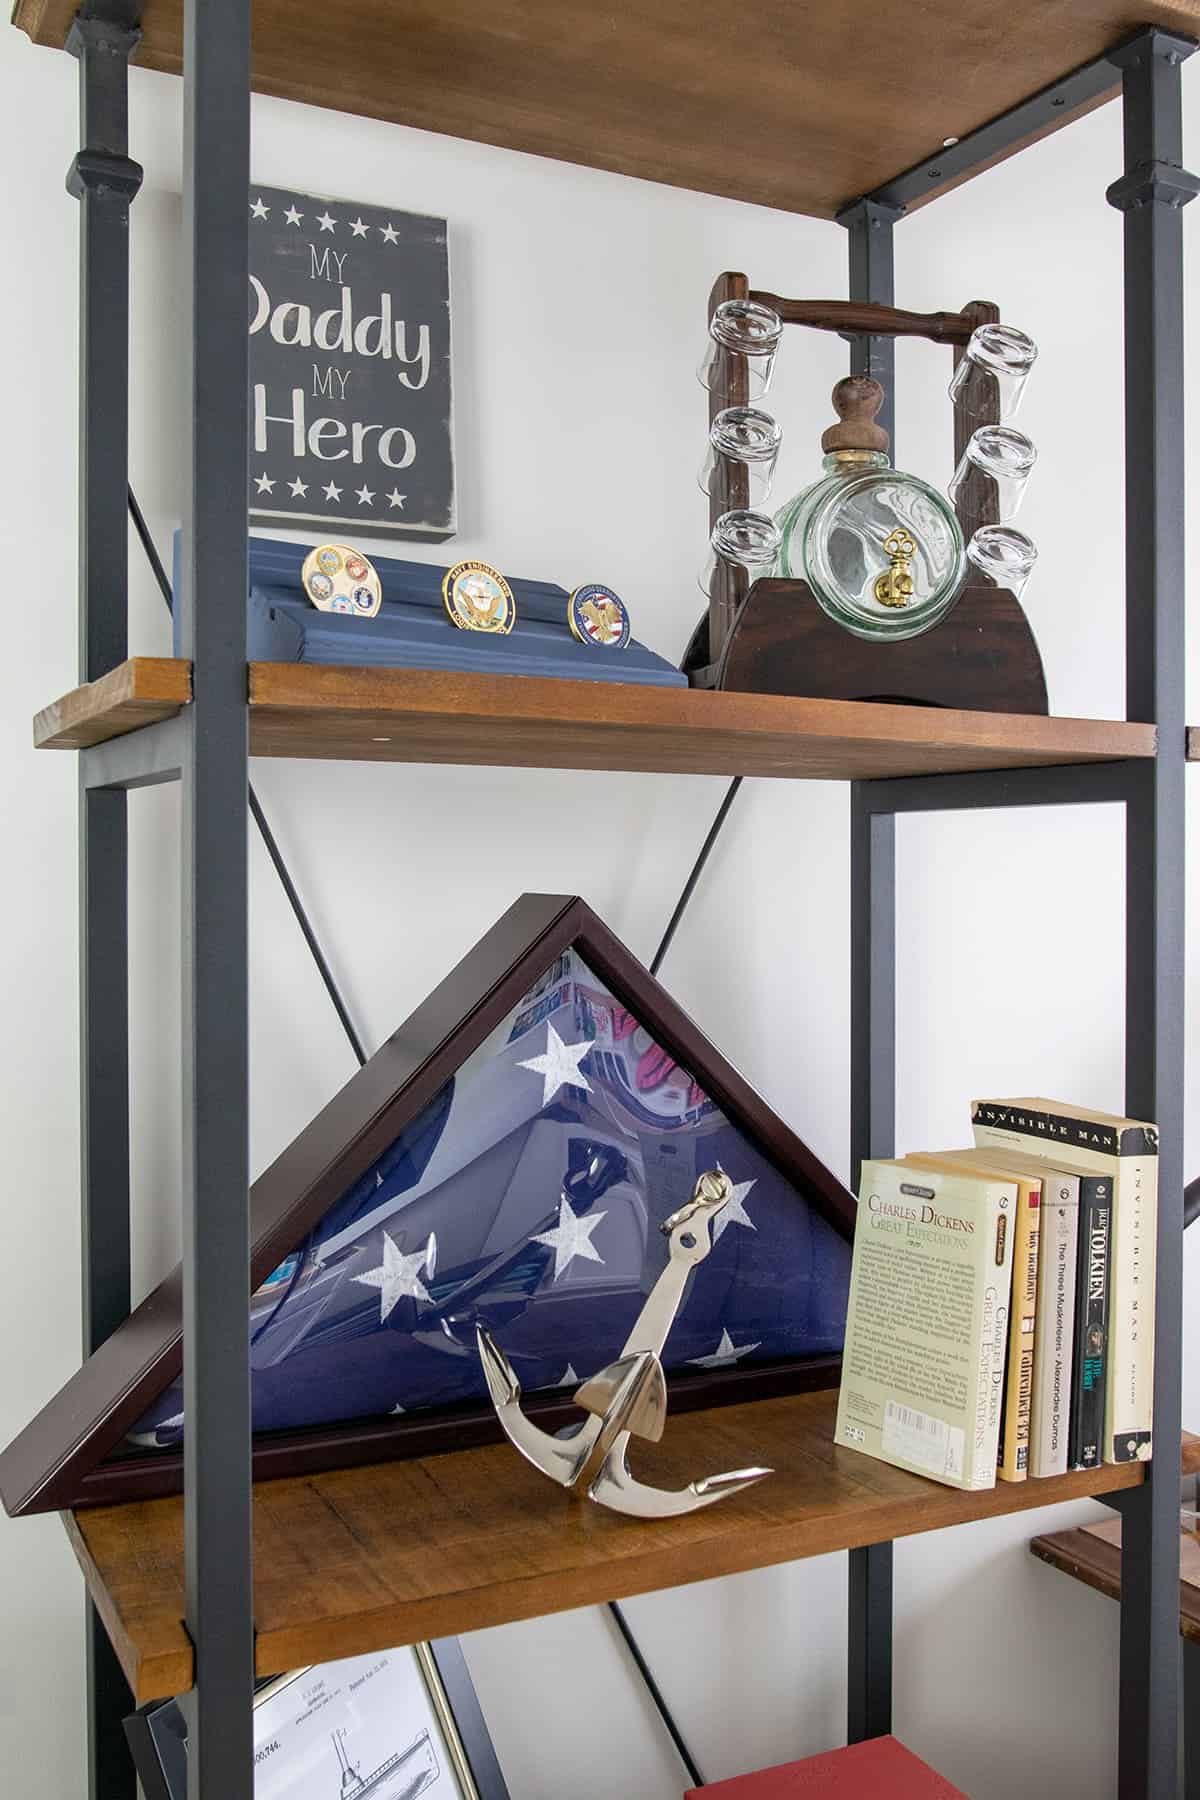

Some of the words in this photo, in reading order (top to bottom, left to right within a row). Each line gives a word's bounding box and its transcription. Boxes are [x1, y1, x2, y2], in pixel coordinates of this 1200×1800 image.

[309, 243, 348, 284] MY
[311, 363, 351, 400] MY
[254, 383, 417, 469] Hero
[977, 1109, 1068, 1136] INVISIBLE
[1078, 1130, 1113, 1146] MAN
[868, 1193, 917, 1220] CHARLES
[920, 1205, 976, 1234] DICKENS
[1058, 1243, 1068, 1261] The
[1088, 1227, 1107, 1300] TOLKIEN
[1056, 1264, 1067, 1290] Three
[983, 1286, 997, 1334] GREAT
[1055, 1291, 1065, 1352] Musketeers
[1130, 1301, 1139, 1342] MAN
[975, 1342, 993, 1449] EXPECTATIONS
[1050, 1360, 1064, 1413] Alexandre
[1050, 1414, 1061, 1450] Dumas
